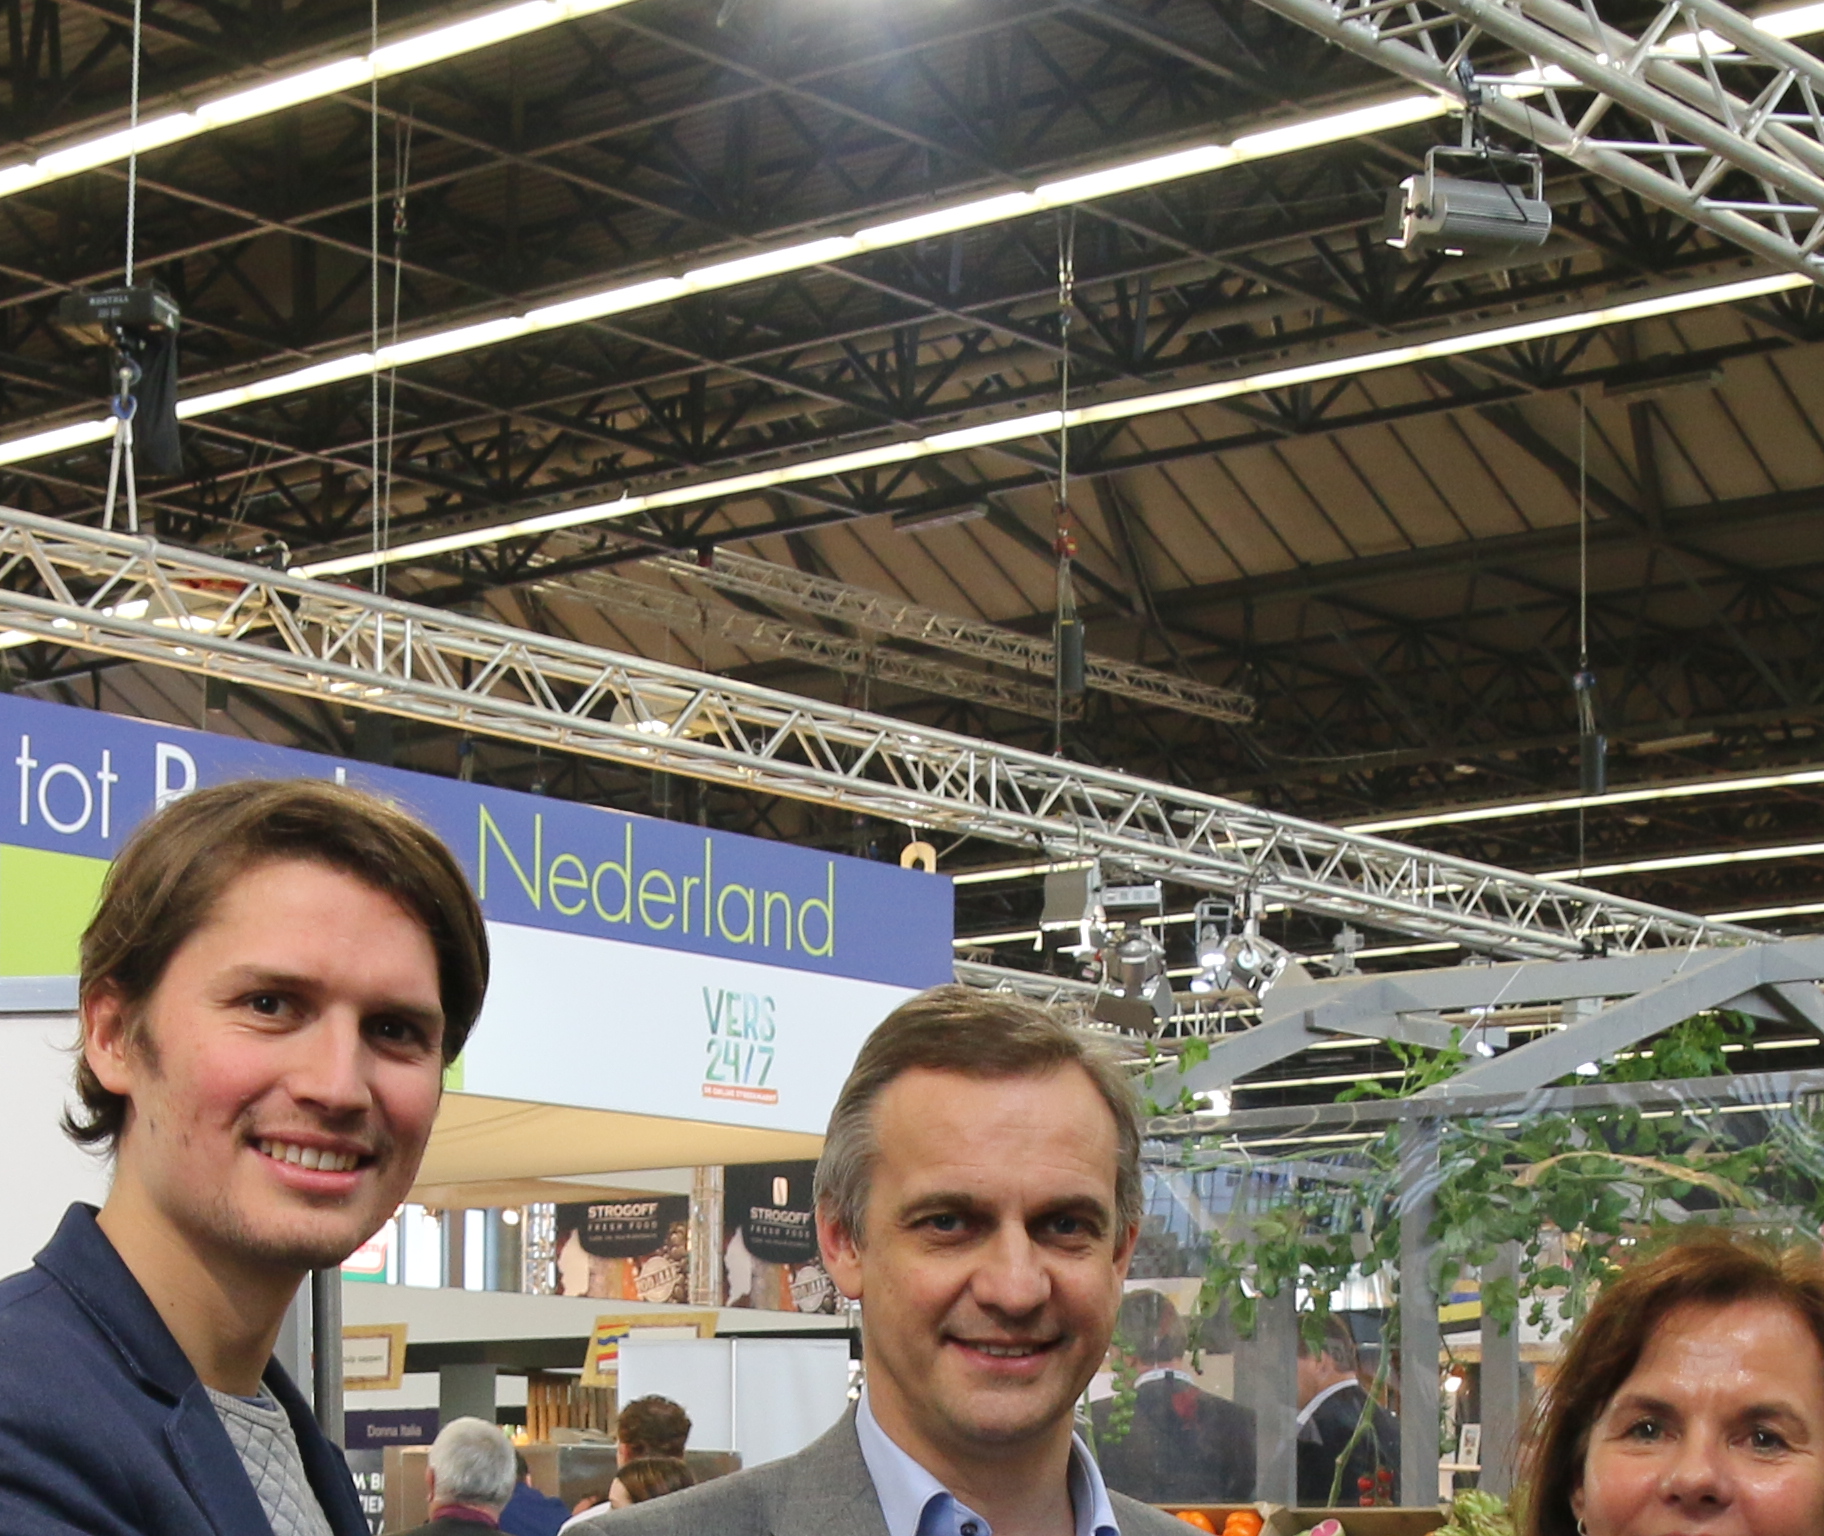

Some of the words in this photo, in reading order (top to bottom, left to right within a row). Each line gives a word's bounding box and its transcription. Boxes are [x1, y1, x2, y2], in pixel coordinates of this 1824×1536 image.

[16, 734, 118, 839] tot
[478, 803, 836, 958] Nederland
[702, 986, 776, 1042] VERS
[706, 1038, 775, 1087] 24/7
[588, 1202, 659, 1219] STROGOFF
[750, 1206, 811, 1225] STROGOFF
